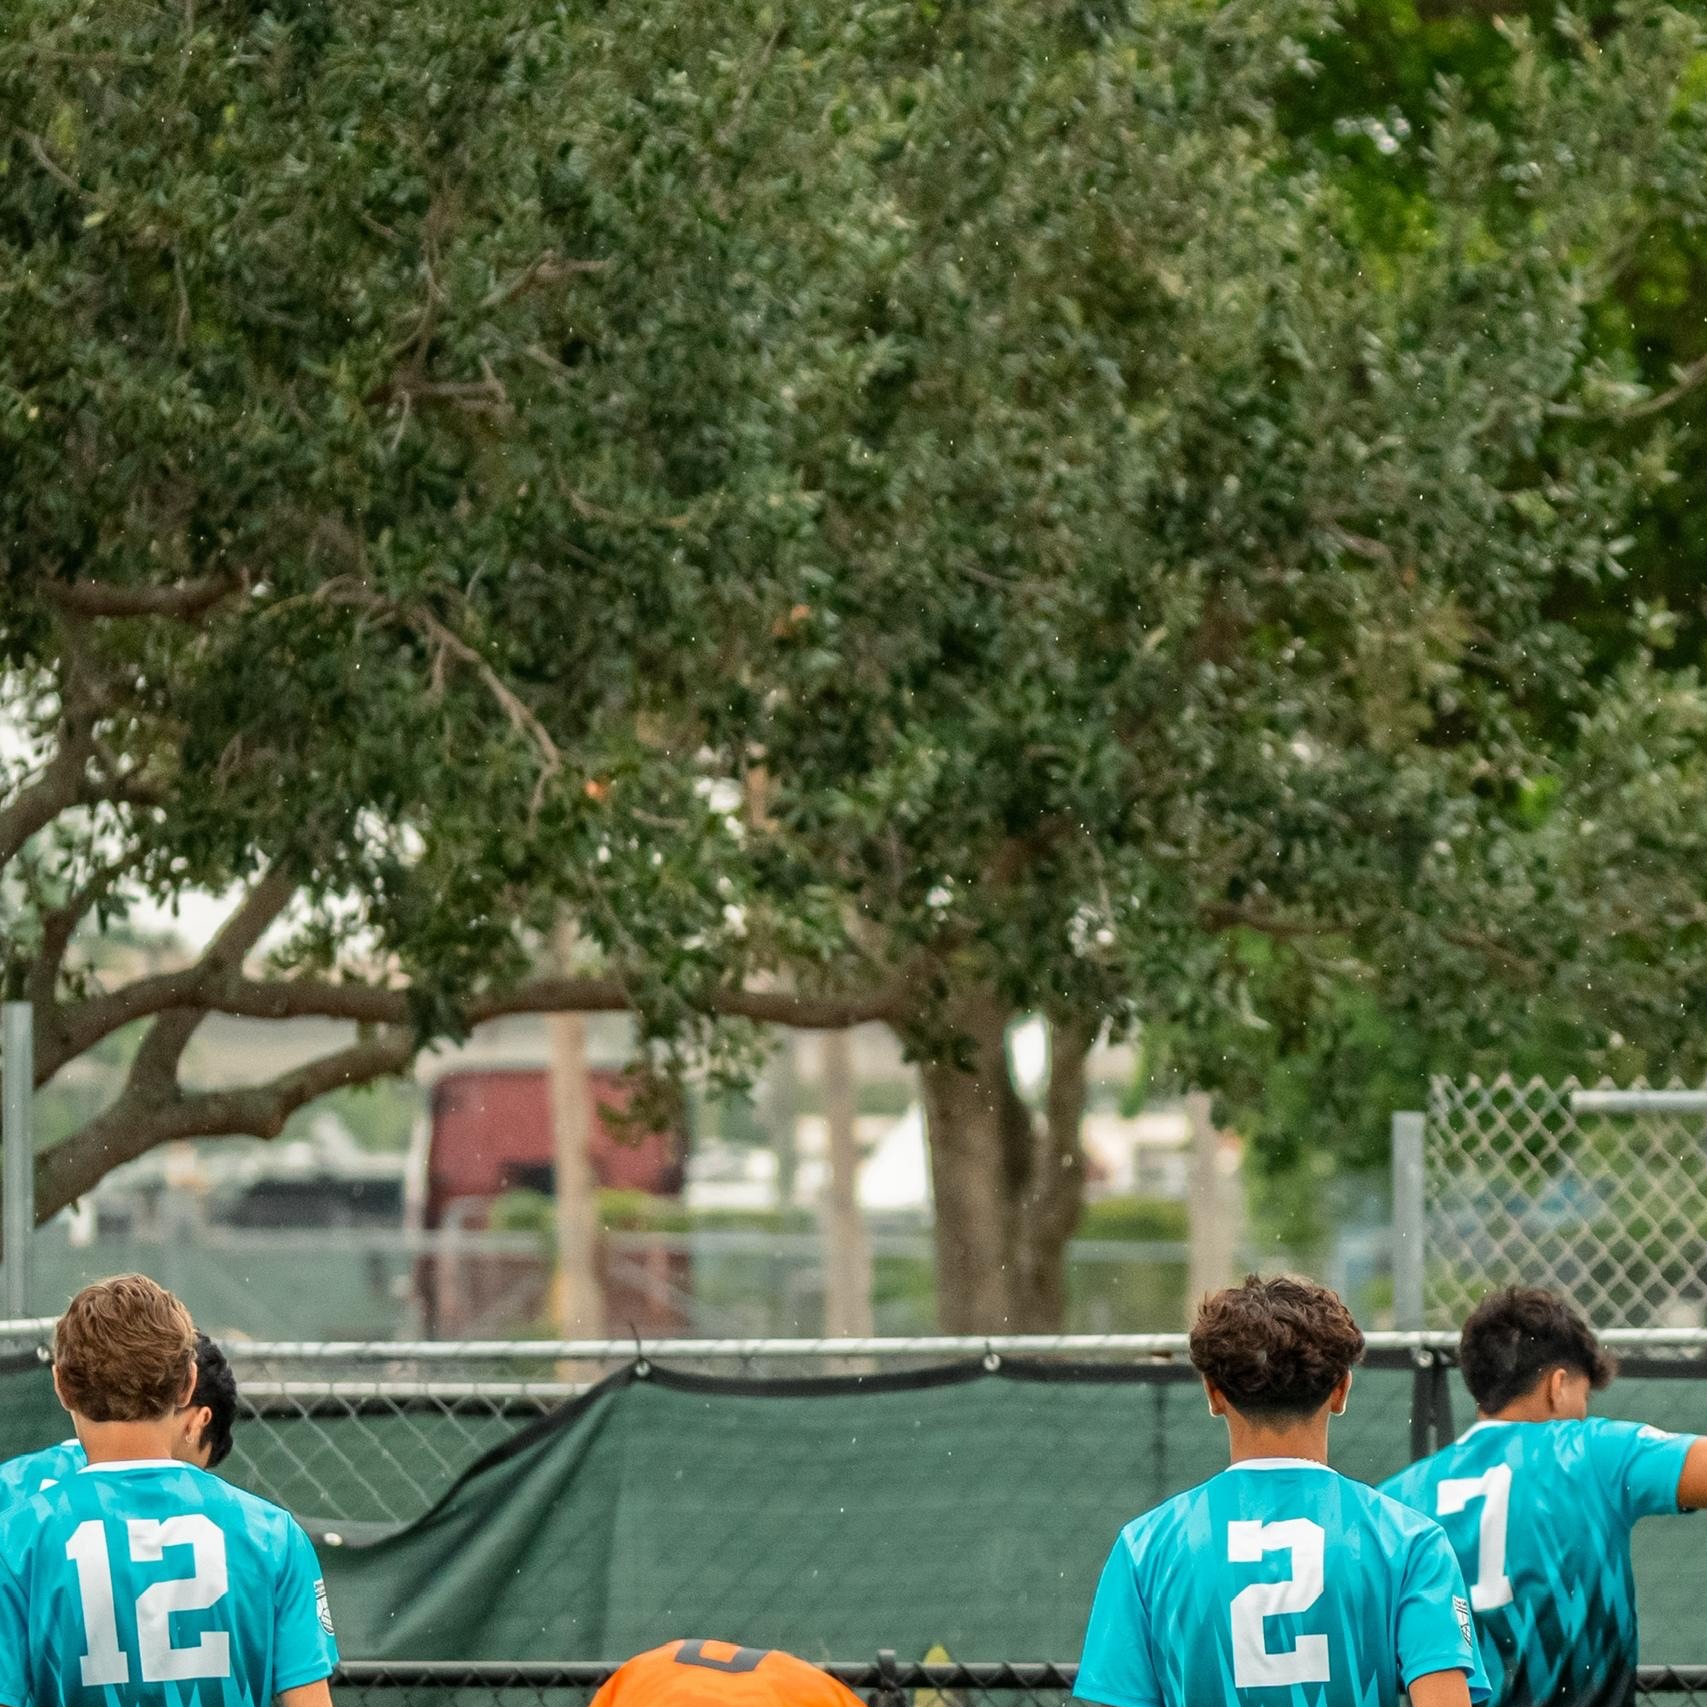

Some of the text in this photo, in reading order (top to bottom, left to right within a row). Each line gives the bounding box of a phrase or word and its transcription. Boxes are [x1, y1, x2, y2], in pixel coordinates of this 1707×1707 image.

[65, 1513, 231, 1686] 12
[1227, 1517, 1330, 1688] 2
[1437, 1463, 1512, 1611] 7
